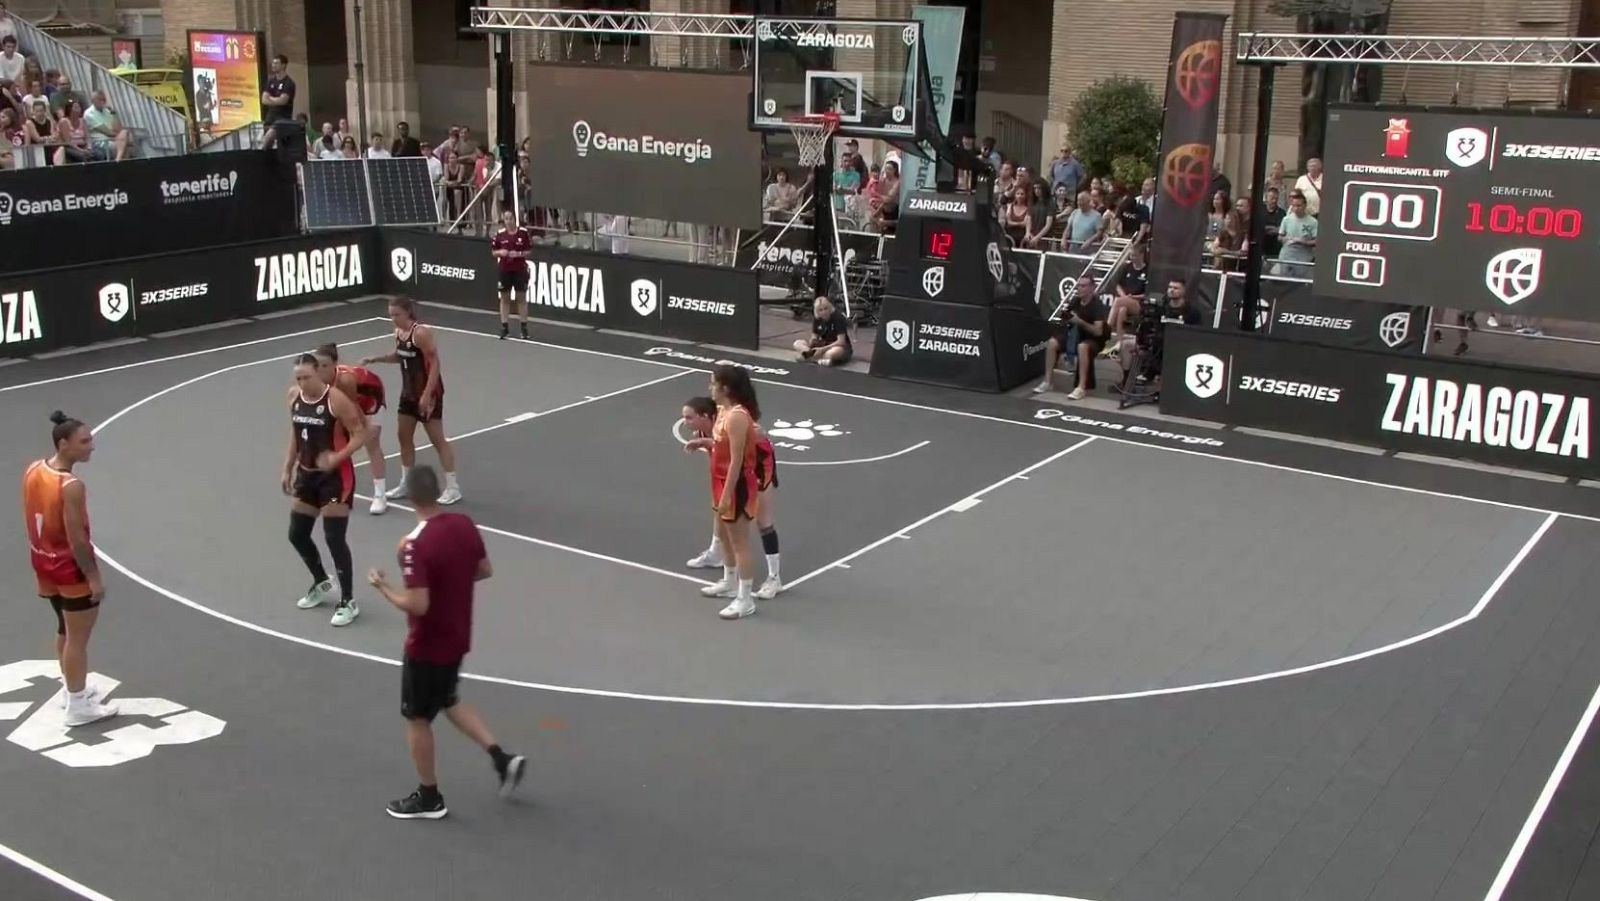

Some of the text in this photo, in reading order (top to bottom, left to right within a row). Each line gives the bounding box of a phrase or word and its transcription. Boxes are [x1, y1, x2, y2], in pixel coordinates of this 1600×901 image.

[796, 32, 874, 49] ZARAGOZA
[592, 132, 712, 164] Gana Energía
[1343, 164, 1432, 178] ELECTROMERCANTIL
[16, 188, 128, 215] Gana Energía
[1490, 185, 1555, 198] SEMI-FINAL
[909, 198, 968, 213] ZARAGOZA
[1357, 191, 1424, 229] 00
[1465, 202, 1582, 239] 10:00
[931, 232, 953, 256] 12
[1345, 241, 1381, 253] FOULS
[254, 244, 364, 302] ZARAGOZA
[421, 262, 476, 280] 3X3SERIES
[1351, 258, 1370, 280] 0
[140, 282, 209, 306] 3X3SERIES
[667, 295, 736, 316] 3X3SERIES
[1278, 312, 1353, 330] 3X3SERIES
[919, 323, 982, 341] 3X3SERIES
[918, 339, 980, 357] ZARAGOZA
[1239, 375, 1341, 403] 3X3SERIES
[1061, 415, 1125, 430] Gana
[1381, 373, 1590, 460] ZARAGOZA
